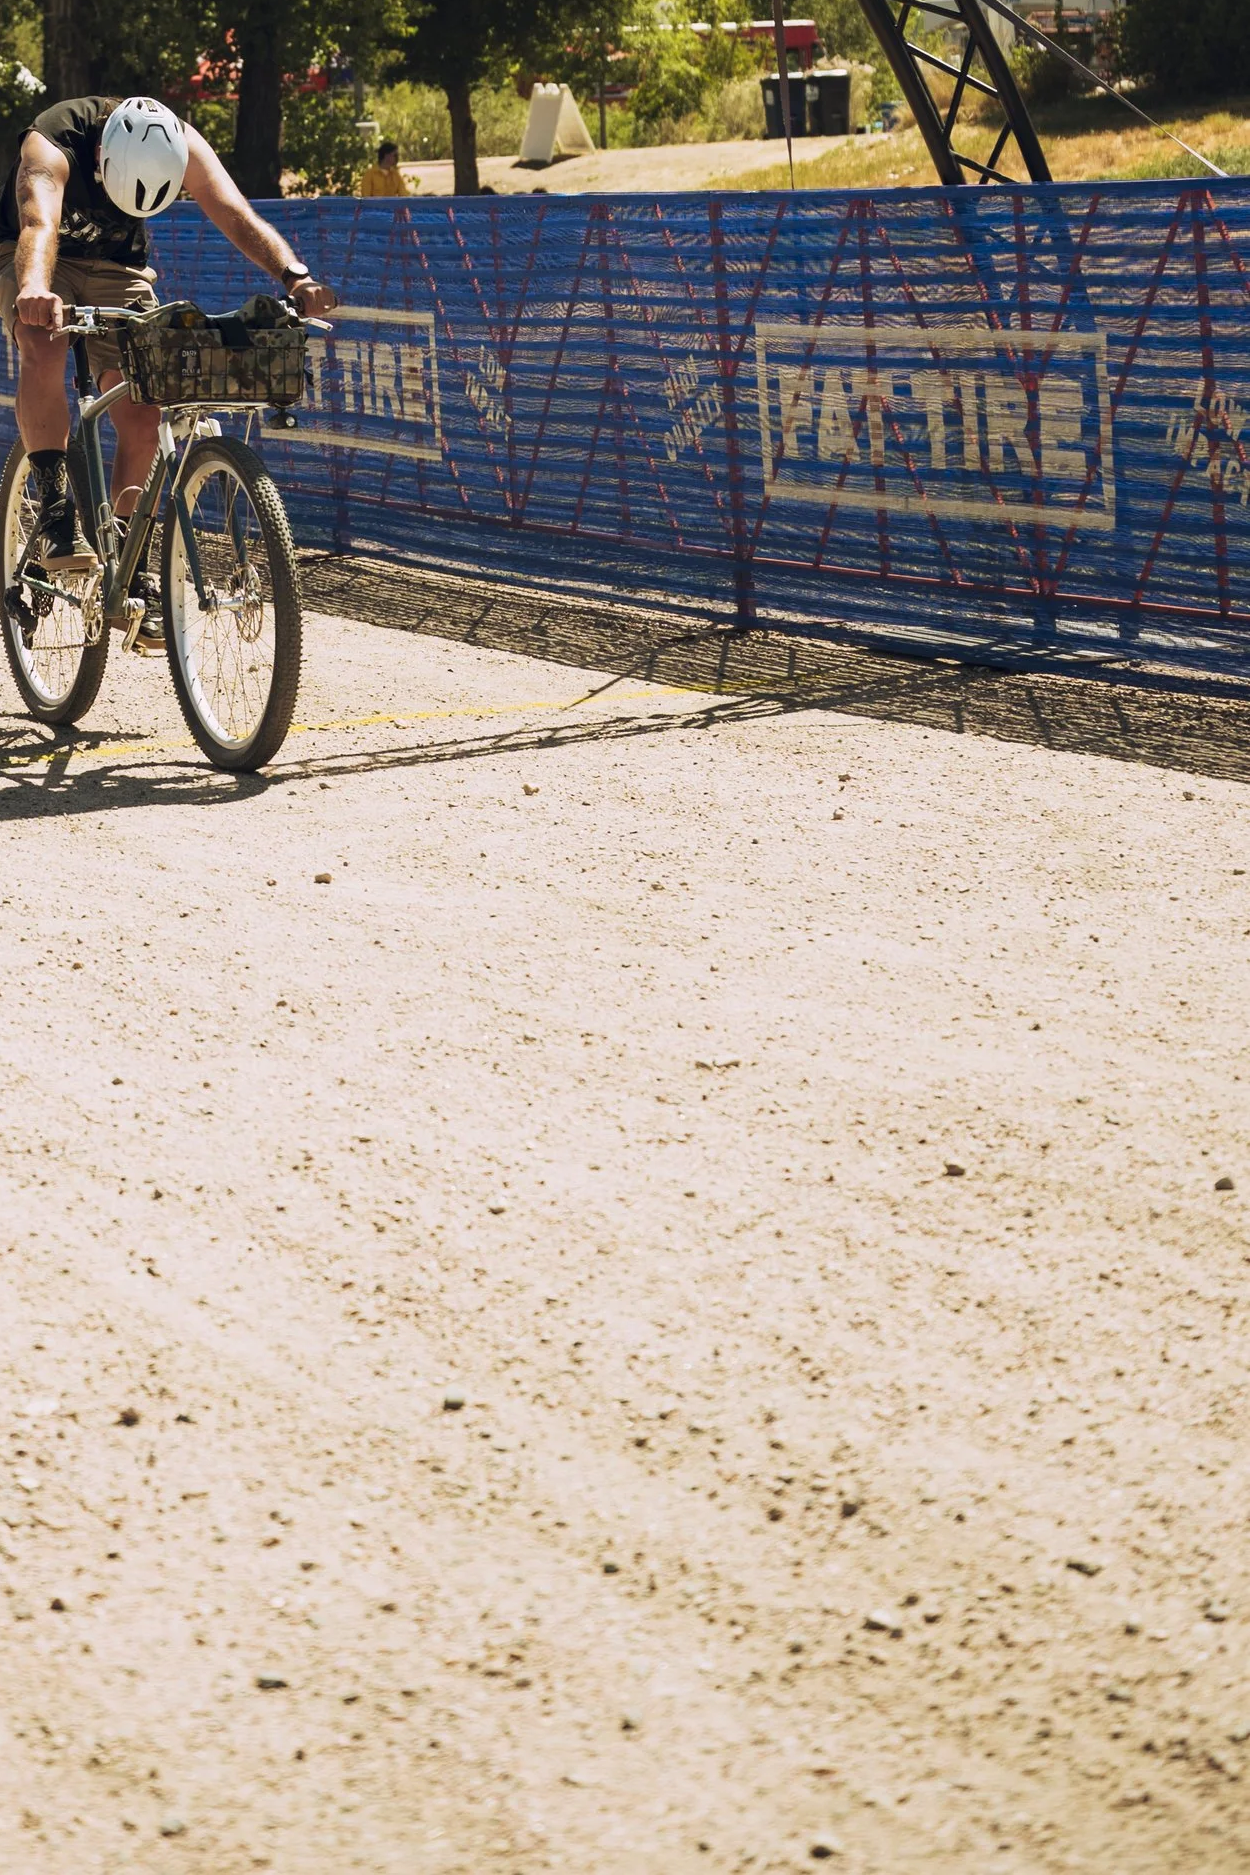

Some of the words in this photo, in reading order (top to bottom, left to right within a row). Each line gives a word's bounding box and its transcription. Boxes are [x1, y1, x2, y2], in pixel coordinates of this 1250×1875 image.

[334, 339, 428, 423] TIRE
[777, 365, 894, 468] FAT
[909, 372, 1088, 478] TIRE
[1193, 377, 1250, 441] LOW
